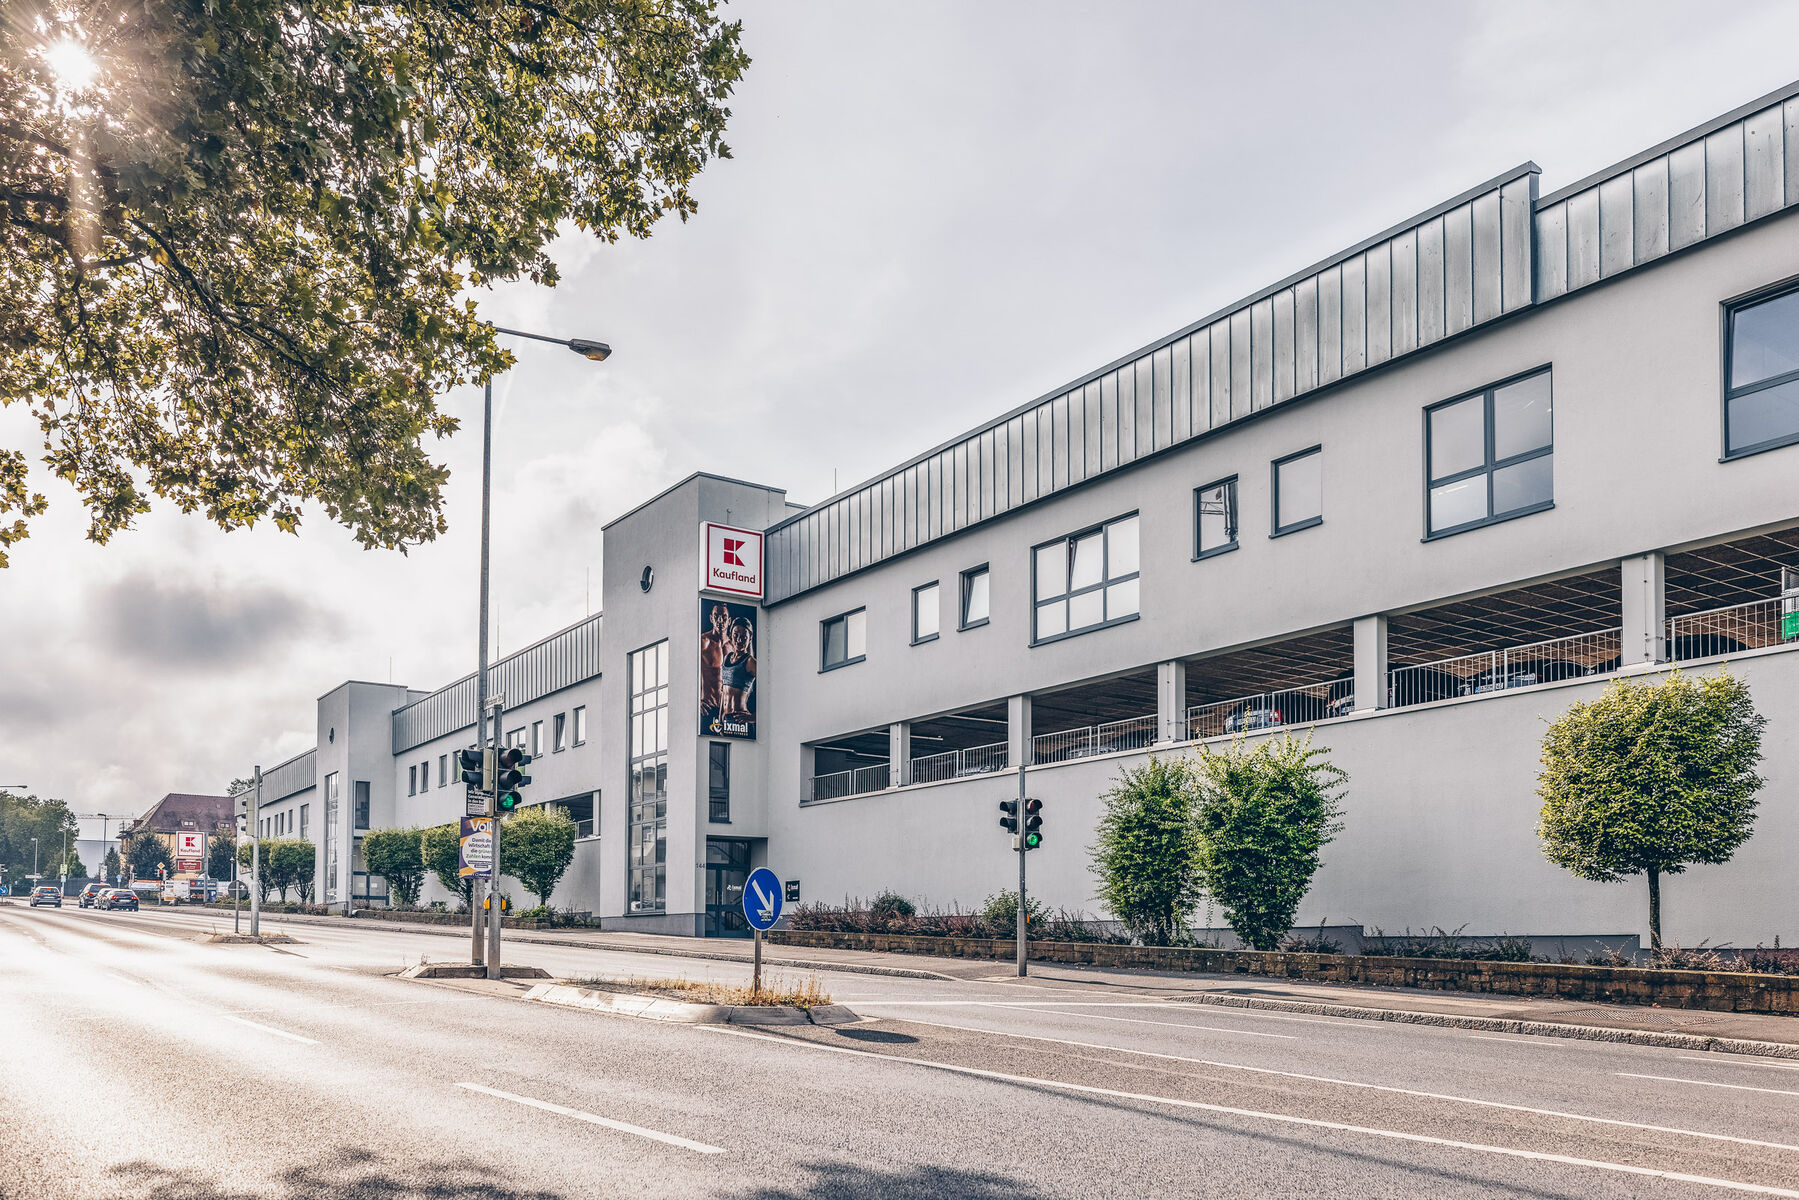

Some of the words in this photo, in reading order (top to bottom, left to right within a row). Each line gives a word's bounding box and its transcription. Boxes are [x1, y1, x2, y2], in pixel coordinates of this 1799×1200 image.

[723, 538, 745, 567] K
[713, 567, 756, 583] Kaufland
[724, 720, 748, 733] ixmal
